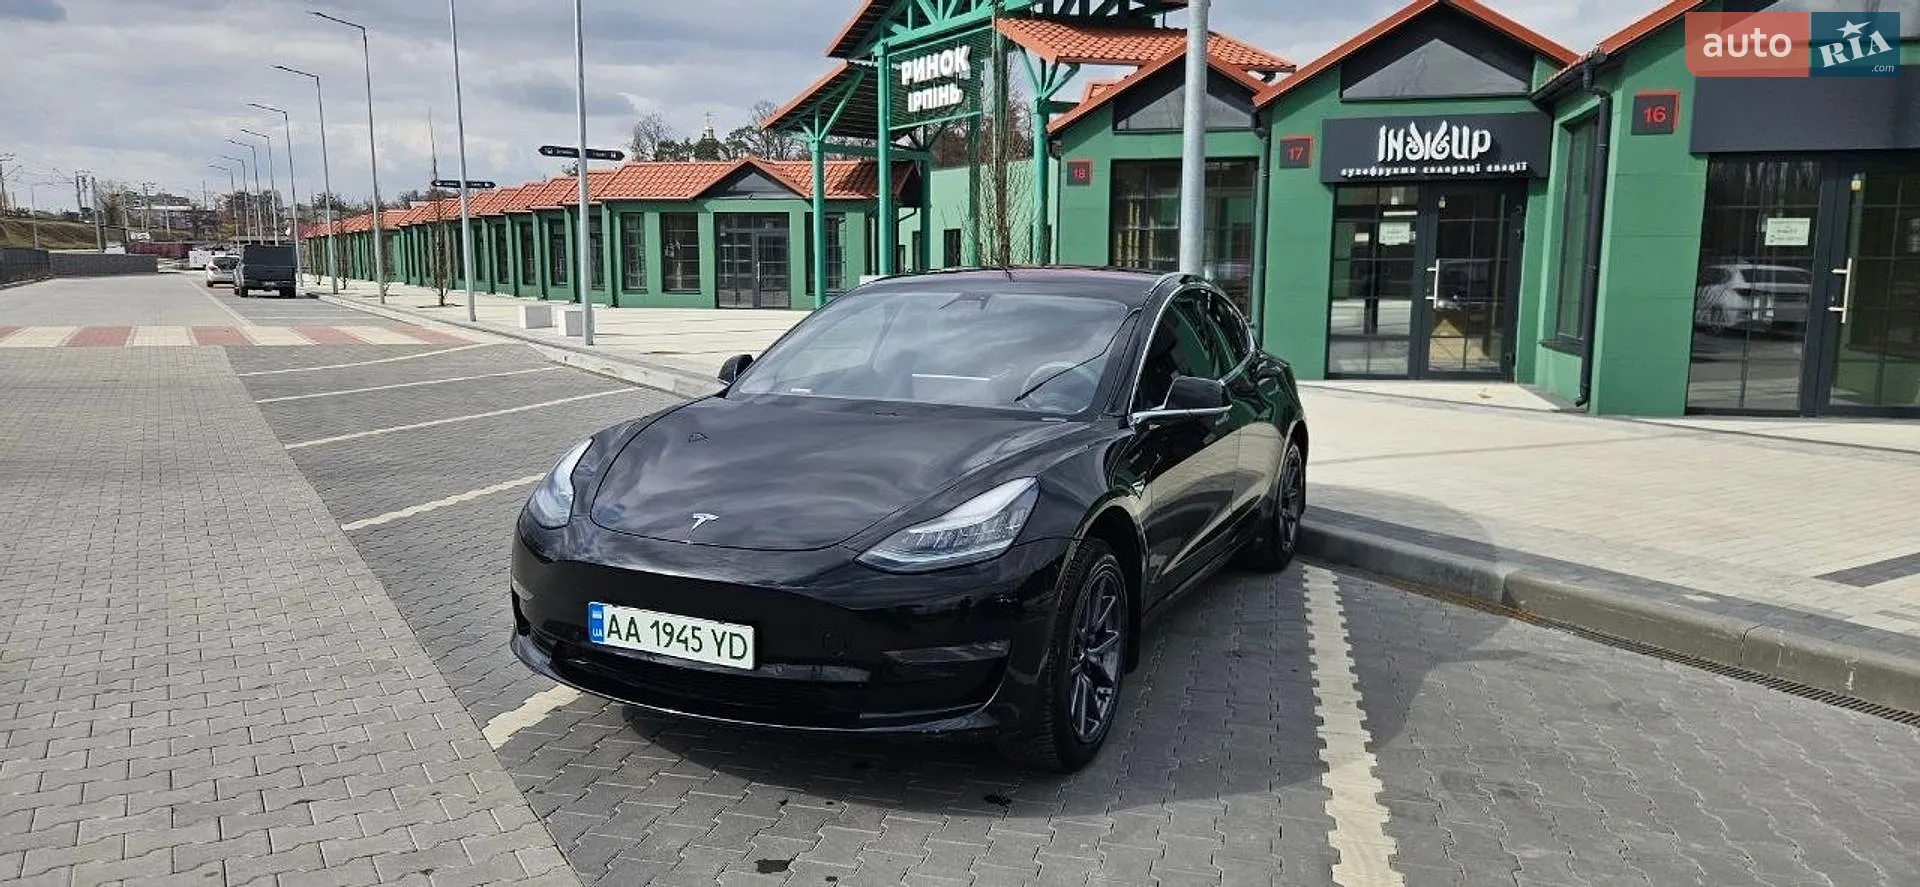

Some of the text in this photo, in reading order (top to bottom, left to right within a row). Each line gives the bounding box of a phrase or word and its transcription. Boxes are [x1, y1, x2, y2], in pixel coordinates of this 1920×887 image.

[901, 45, 971, 85] РИНОК
[907, 83, 965, 113] ІРПІНЬ
[1643, 105, 1667, 124] 16
[1287, 146, 1304, 161] 17
[1072, 167, 1086, 180] 18
[607, 613, 747, 661] AA 1945 YD
